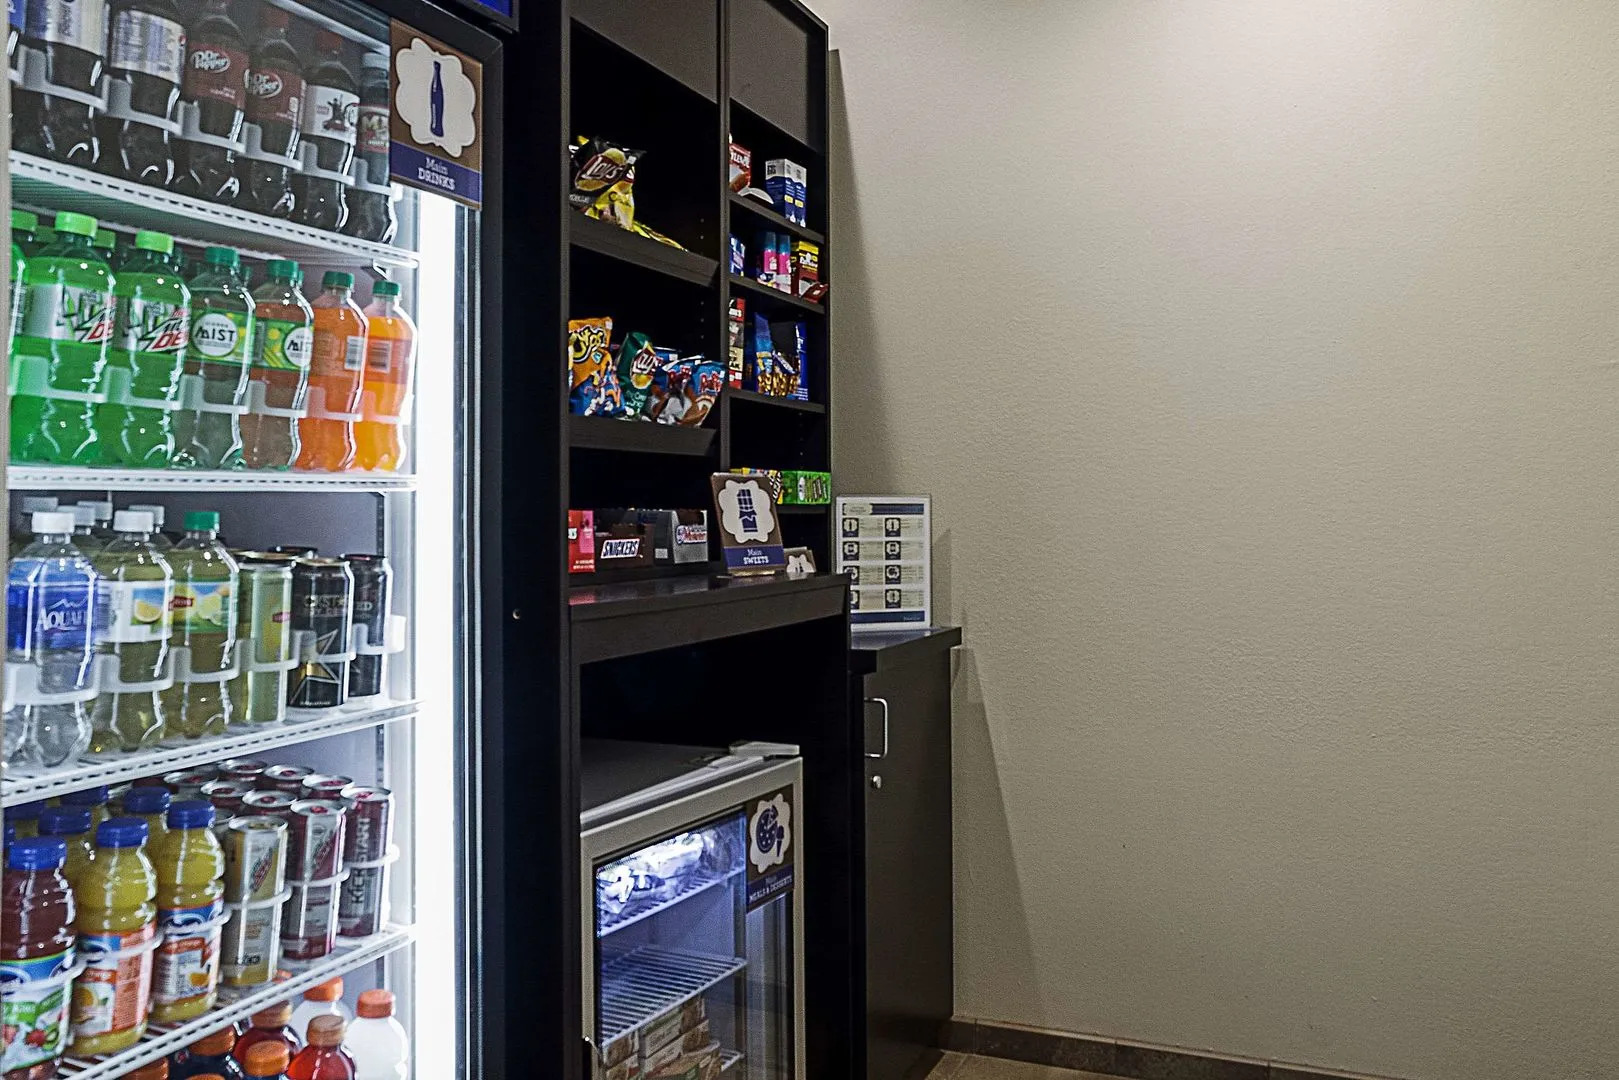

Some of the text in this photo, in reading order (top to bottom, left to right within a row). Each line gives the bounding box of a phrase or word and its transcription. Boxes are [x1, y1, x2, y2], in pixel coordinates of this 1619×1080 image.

[425, 157, 448, 174] Main
[418, 168, 455, 190] DRINKS
[195, 325, 236, 343] MIST
[603, 540, 638, 557] SNICKERS
[743, 556, 770, 565] SWEETS
